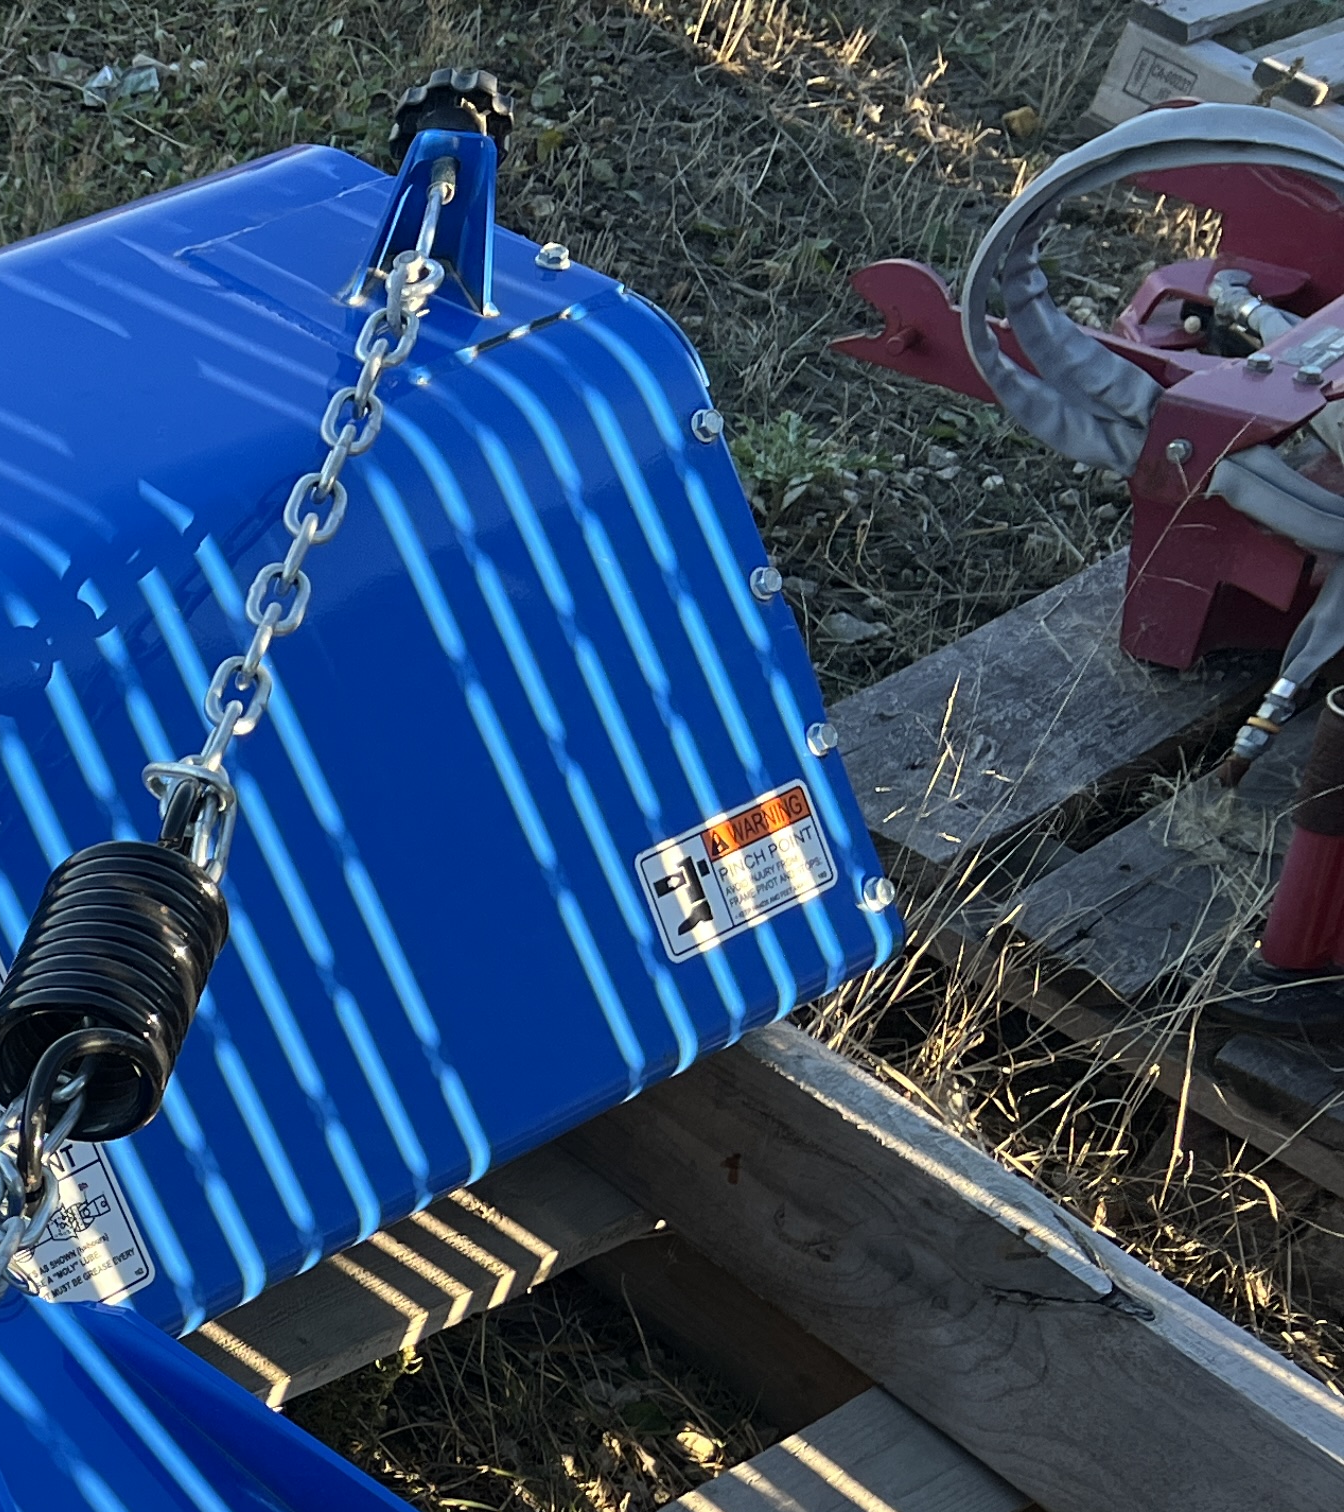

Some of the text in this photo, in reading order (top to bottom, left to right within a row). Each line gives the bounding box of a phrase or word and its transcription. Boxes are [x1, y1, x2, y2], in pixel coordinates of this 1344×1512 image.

[726, 792, 803, 846] WARNING
[717, 824, 814, 882] PINCH POINT
[755, 876, 779, 894] PIVOT
[37, 1262, 49, 1274] AS
[48, 1248, 77, 1269] SHOWN
[50, 1281, 72, 1297] MUST
[71, 1275, 83, 1287] BE
[81, 1259, 113, 1281] GREASE
[111, 1247, 136, 1265] EVERY
